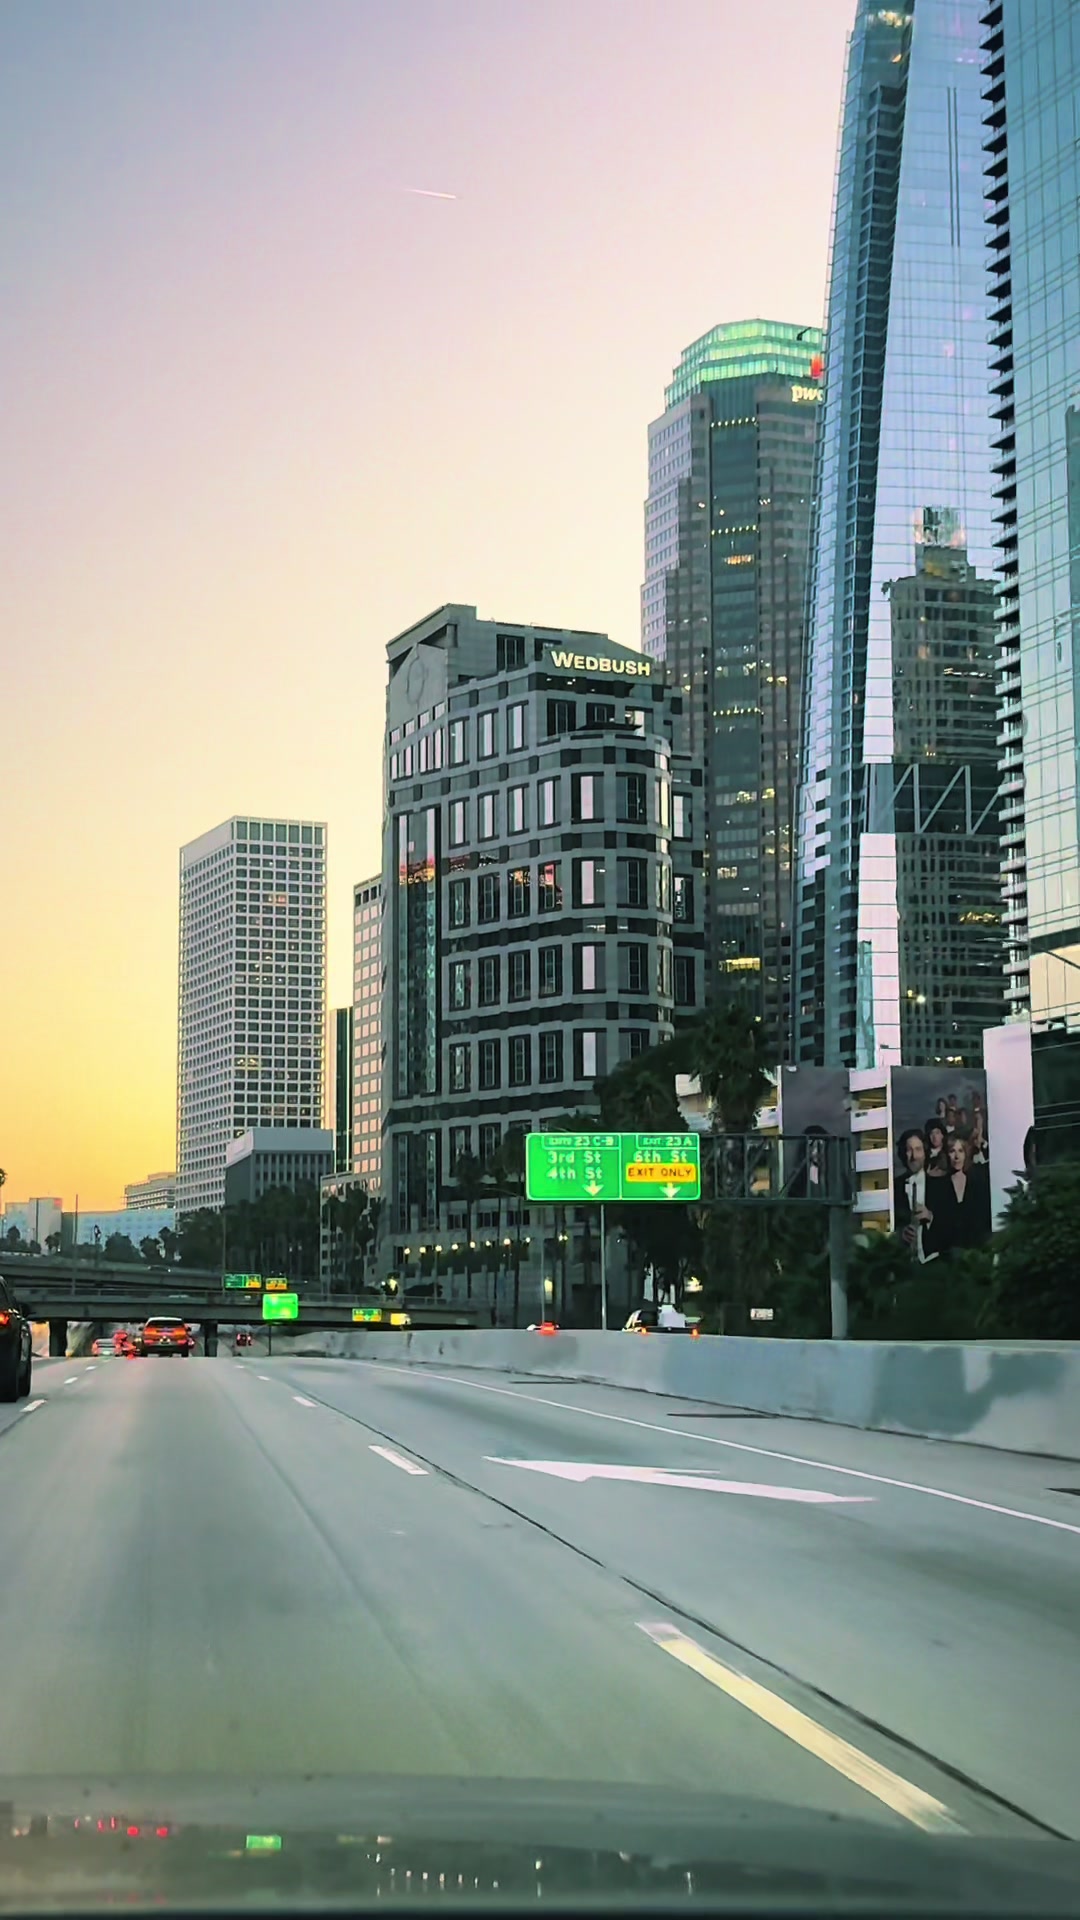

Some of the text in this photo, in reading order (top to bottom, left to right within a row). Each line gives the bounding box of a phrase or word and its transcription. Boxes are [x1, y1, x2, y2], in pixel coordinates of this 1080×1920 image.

[642, 1137, 662, 1146] EXIT
[547, 1150, 602, 1164] 3rd St
[632, 1150, 688, 1163] 6th St
[546, 1166, 603, 1180] 4th St
[627, 1167, 693, 1177] EXIT ONLY
